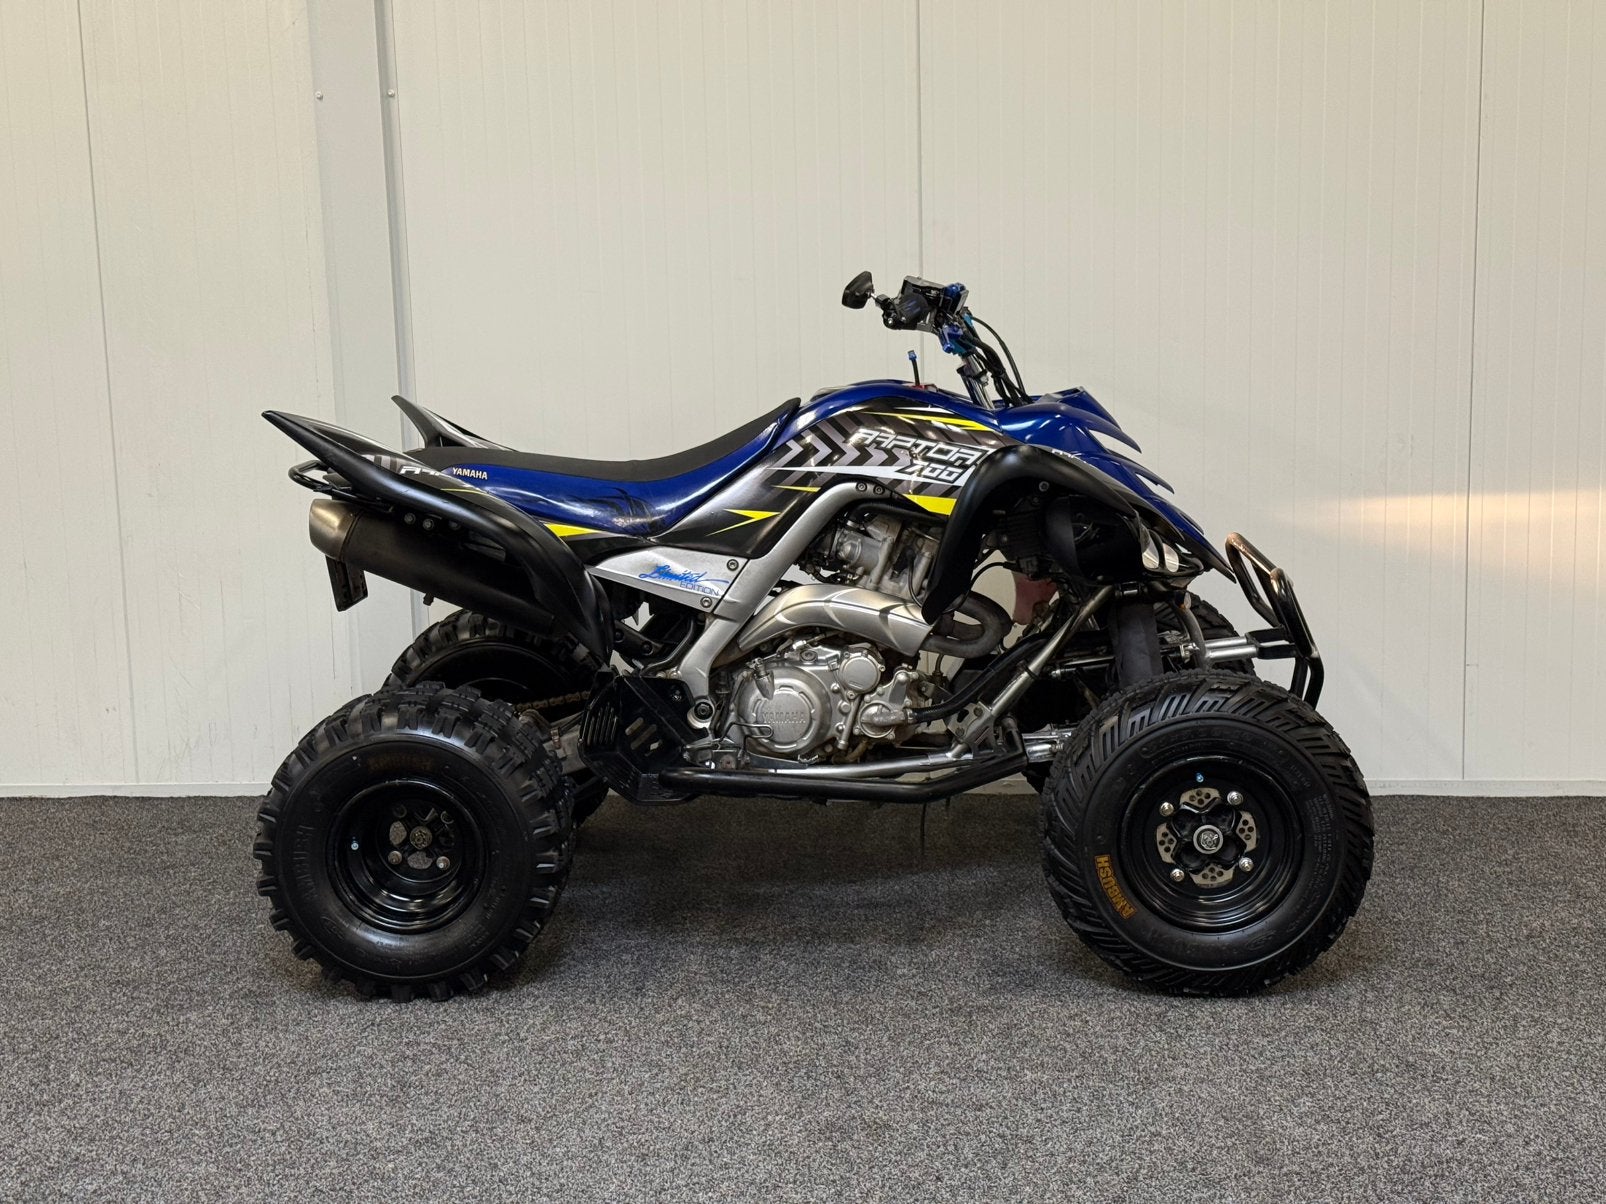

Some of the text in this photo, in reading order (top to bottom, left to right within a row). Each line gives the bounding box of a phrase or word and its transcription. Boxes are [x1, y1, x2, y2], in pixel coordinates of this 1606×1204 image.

[452, 467, 488, 480] YAMAHA
[904, 460, 964, 482] 700
[680, 581, 720, 597] EDITION
[762, 711, 807, 724] YAMAHA
[1094, 854, 1138, 920] AMBUSH
